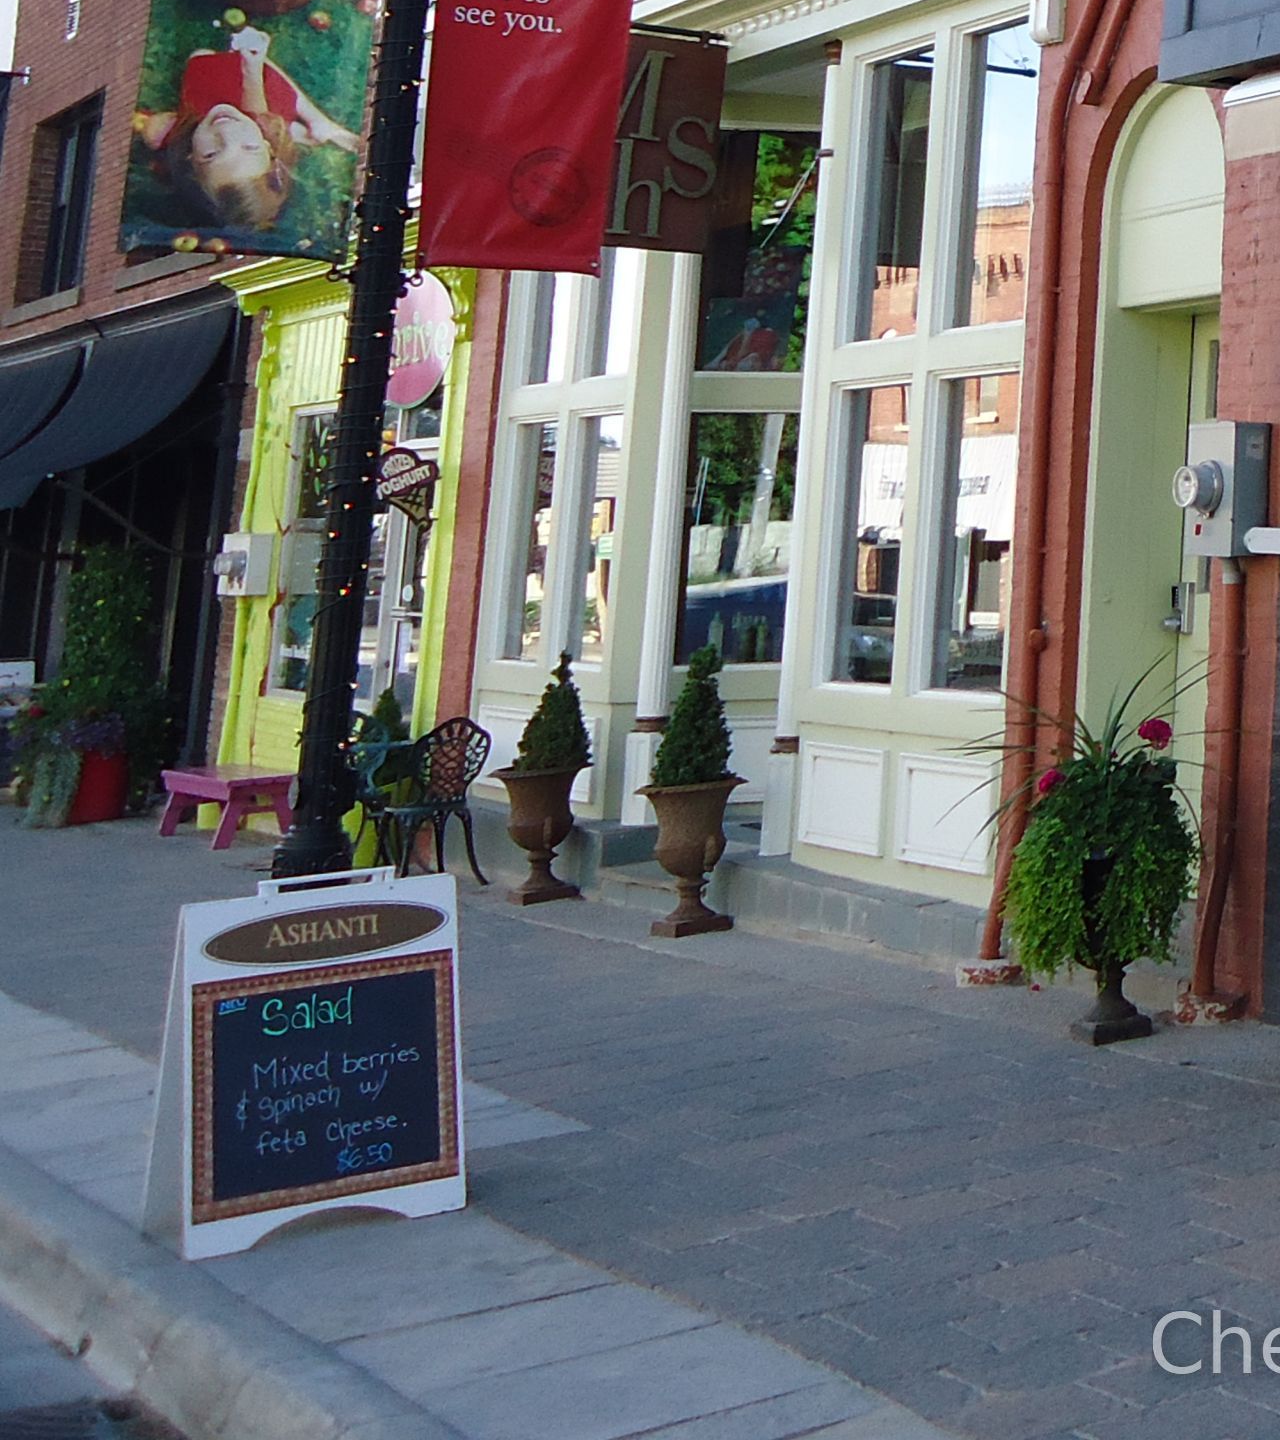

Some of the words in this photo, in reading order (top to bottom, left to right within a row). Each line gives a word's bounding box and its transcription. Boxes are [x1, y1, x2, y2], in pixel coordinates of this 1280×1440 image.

[454, 5, 496, 26] see
[504, 12, 563, 37] you.
[265, 913, 379, 950] ASHANTI
[261, 986, 353, 1036] Salad
[252, 1050, 330, 1090] Mixed
[343, 1043, 421, 1074] berries
